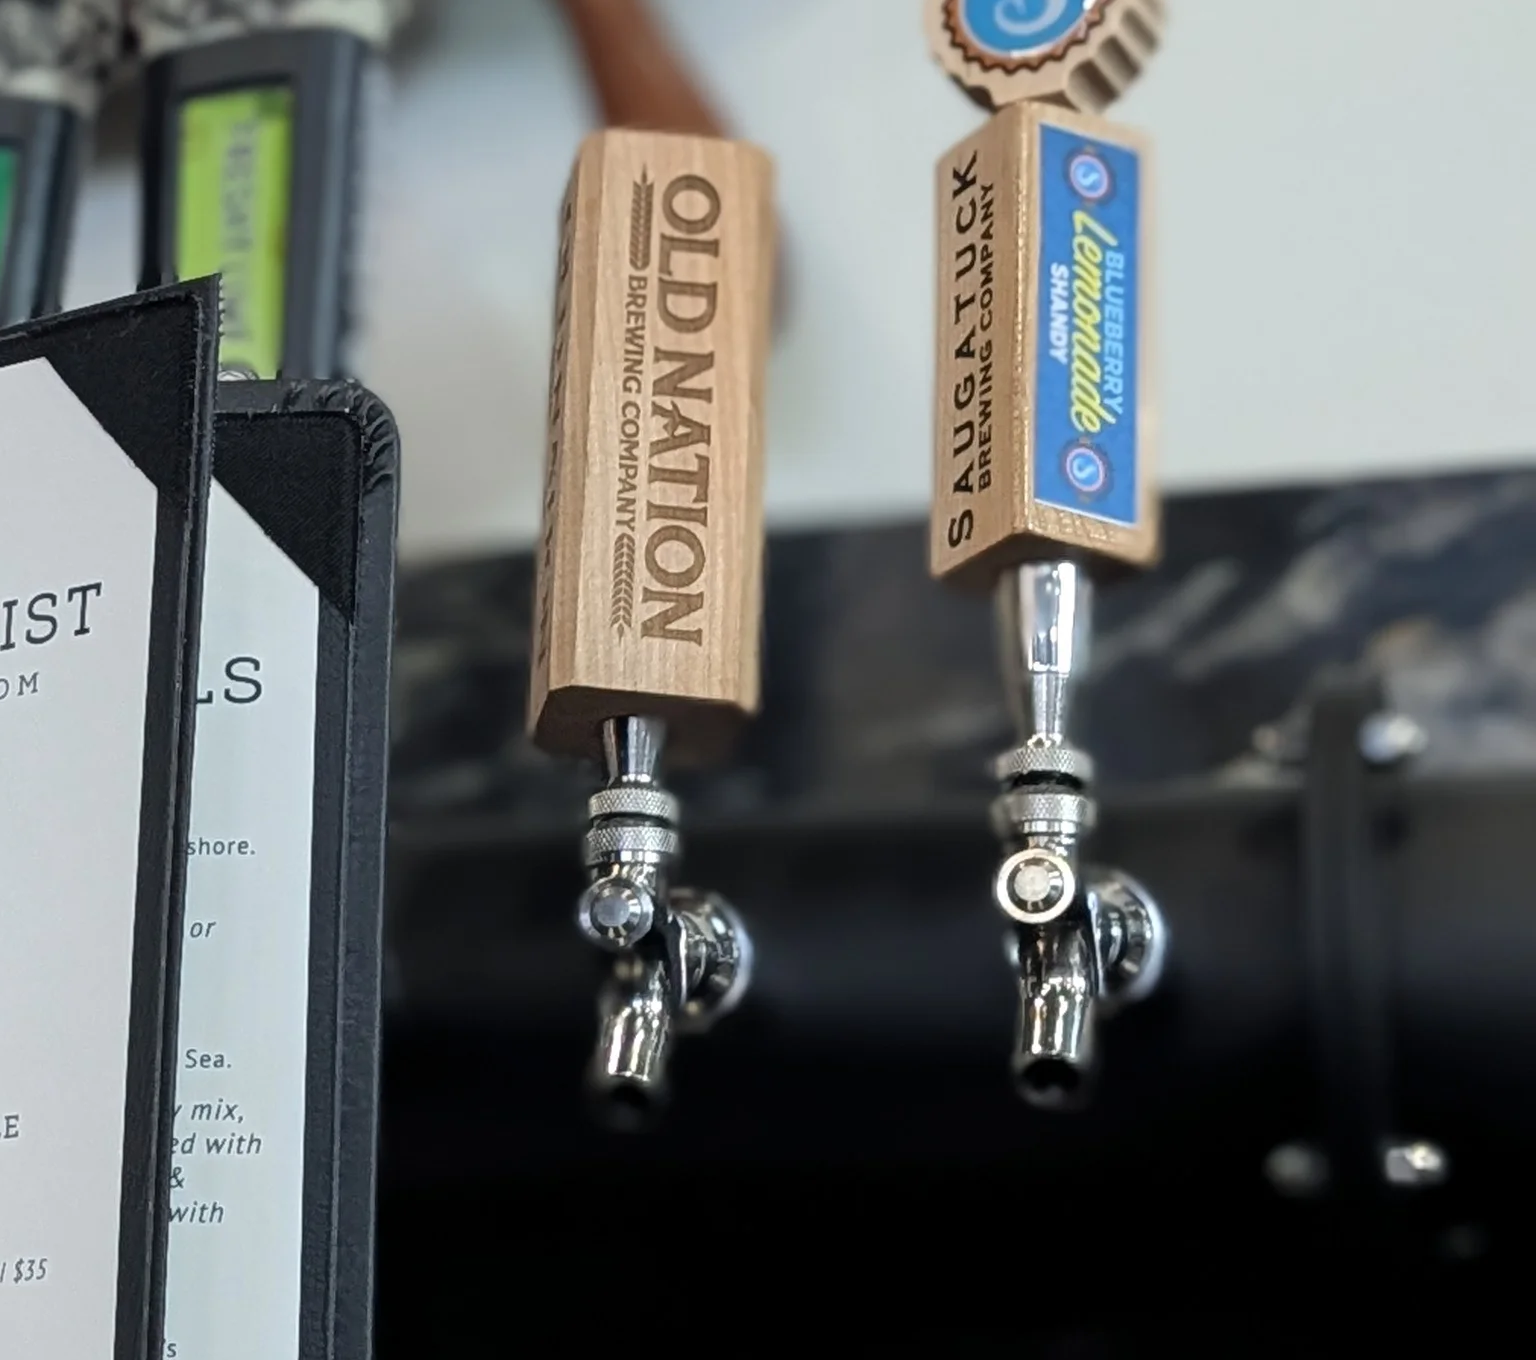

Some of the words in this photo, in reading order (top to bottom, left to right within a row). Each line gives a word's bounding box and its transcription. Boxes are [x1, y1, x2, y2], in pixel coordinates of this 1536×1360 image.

[656, 173, 722, 334] OLD
[979, 183, 994, 332] COMPANY
[1049, 262, 1069, 365] SHANDY
[622, 274, 648, 394] BREWING
[948, 150, 979, 549] SAUGATUCK
[1071, 209, 1119, 434] Lemonade
[1103, 249, 1125, 415] BLUEBERRY
[614, 399, 640, 533] COMPANY
[978, 339, 994, 495] BREWING
[640, 344, 716, 646] NATION
[189, 921, 216, 938] or
[184, 1049, 232, 1069] Sea.
[191, 1098, 244, 1124] mix,
[206, 1132, 262, 1154] with
[13, 1257, 48, 1284] $35
[169, 1200, 224, 1224] with
